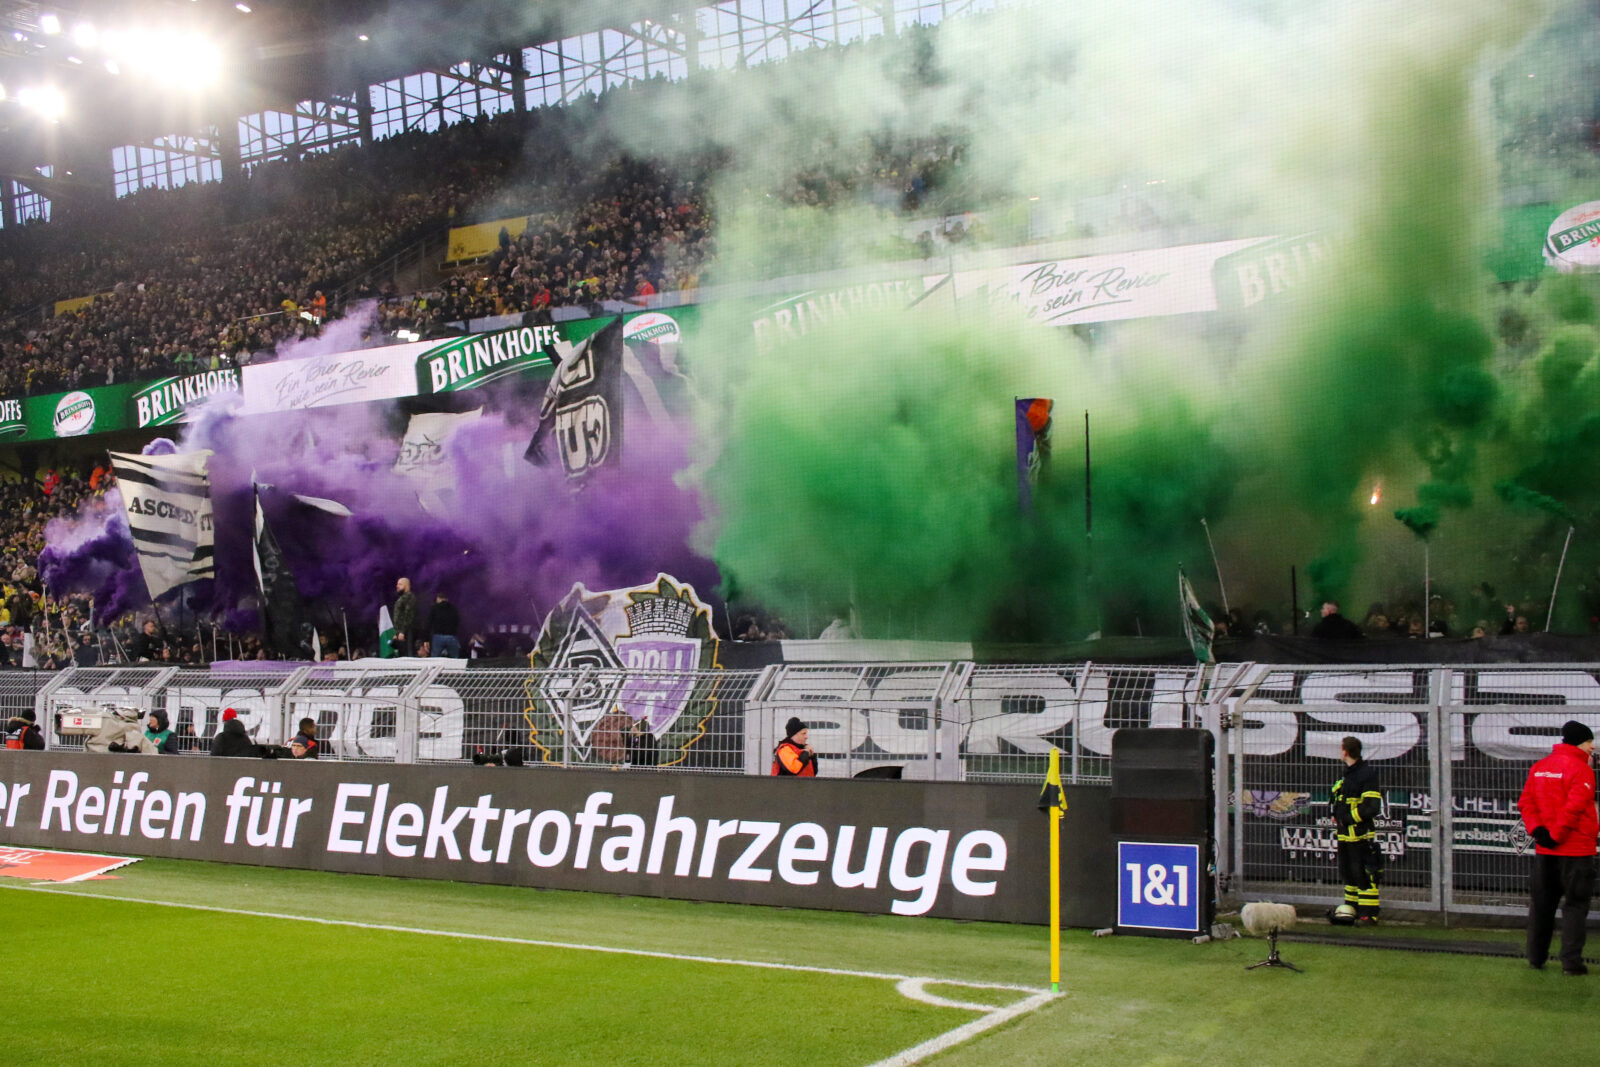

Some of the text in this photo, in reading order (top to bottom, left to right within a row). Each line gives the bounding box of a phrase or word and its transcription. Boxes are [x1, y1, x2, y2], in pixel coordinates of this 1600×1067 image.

[1560, 222, 1600, 247] BRIN
[1021, 262, 1088, 298] Bier
[1043, 289, 1083, 313] sein
[340, 361, 390, 387] Revier
[429, 325, 562, 394] BRINKHOFF's
[137, 369, 239, 428] BRINKHOFF's
[39, 770, 207, 842] Reifen
[224, 776, 313, 848] für
[327, 782, 1007, 916] Elektrofahrzeuge
[1126, 863, 1188, 907] 1&1
